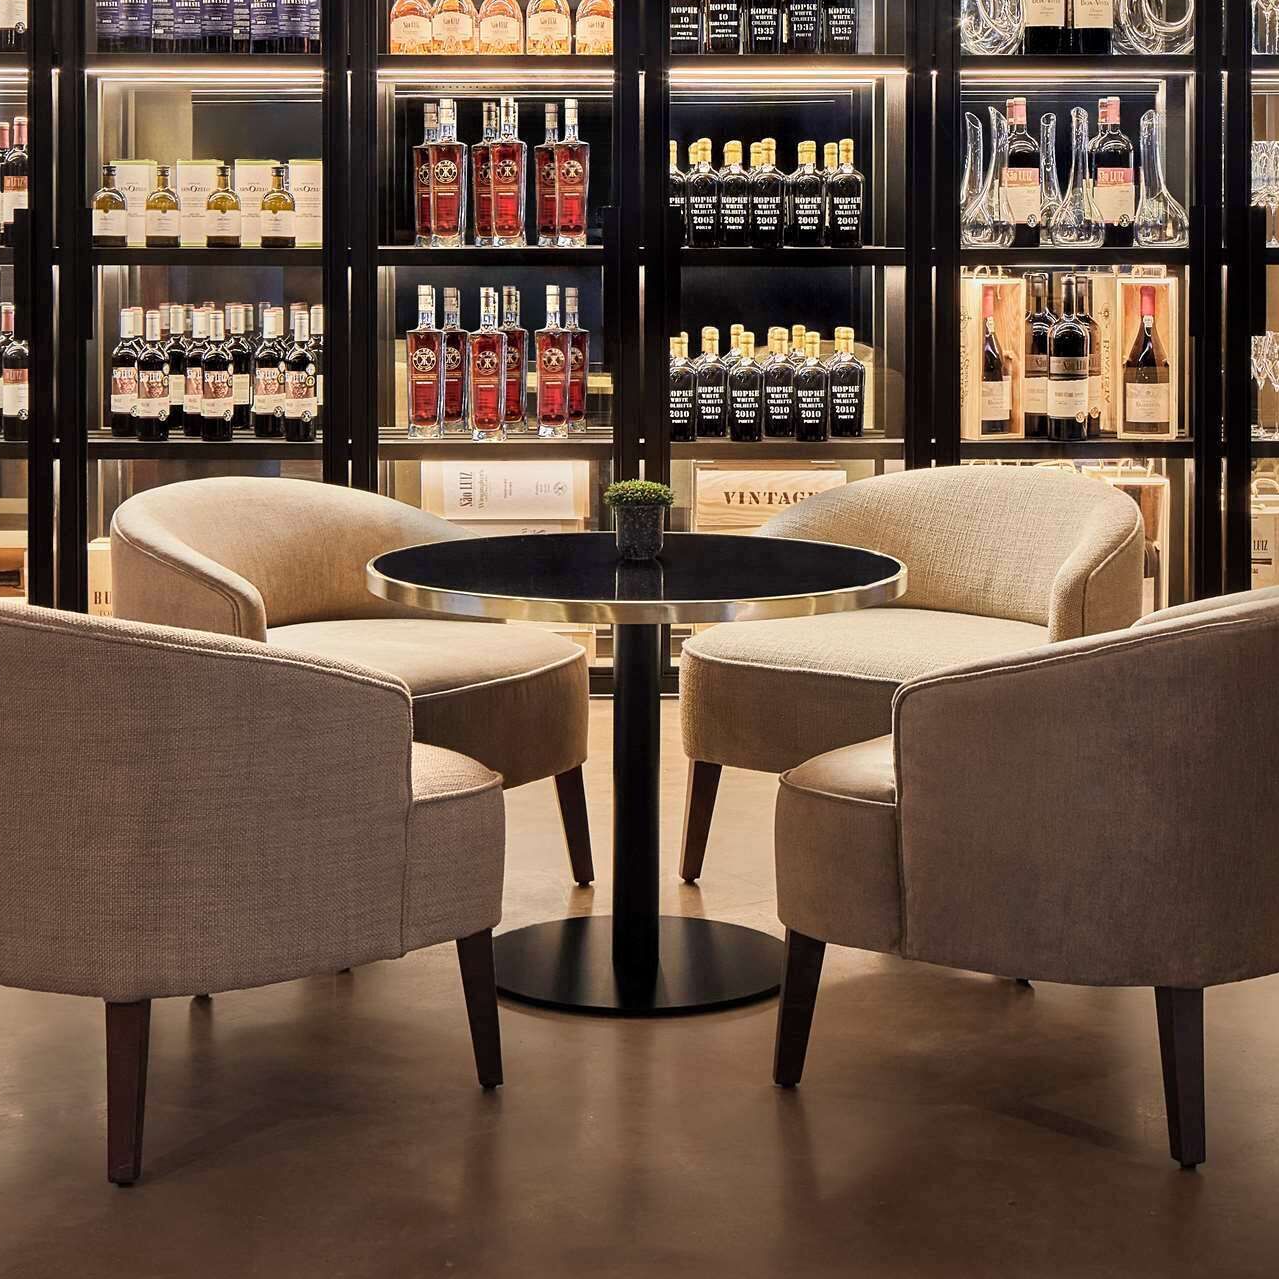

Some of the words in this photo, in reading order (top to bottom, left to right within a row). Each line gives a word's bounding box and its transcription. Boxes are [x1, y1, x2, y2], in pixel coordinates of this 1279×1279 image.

[459, 471, 473, 490] LUIZ
[459, 492, 473, 507] São
[724, 491, 819, 506] VINTAG
[1253, 539, 1268, 551] LUIZ
